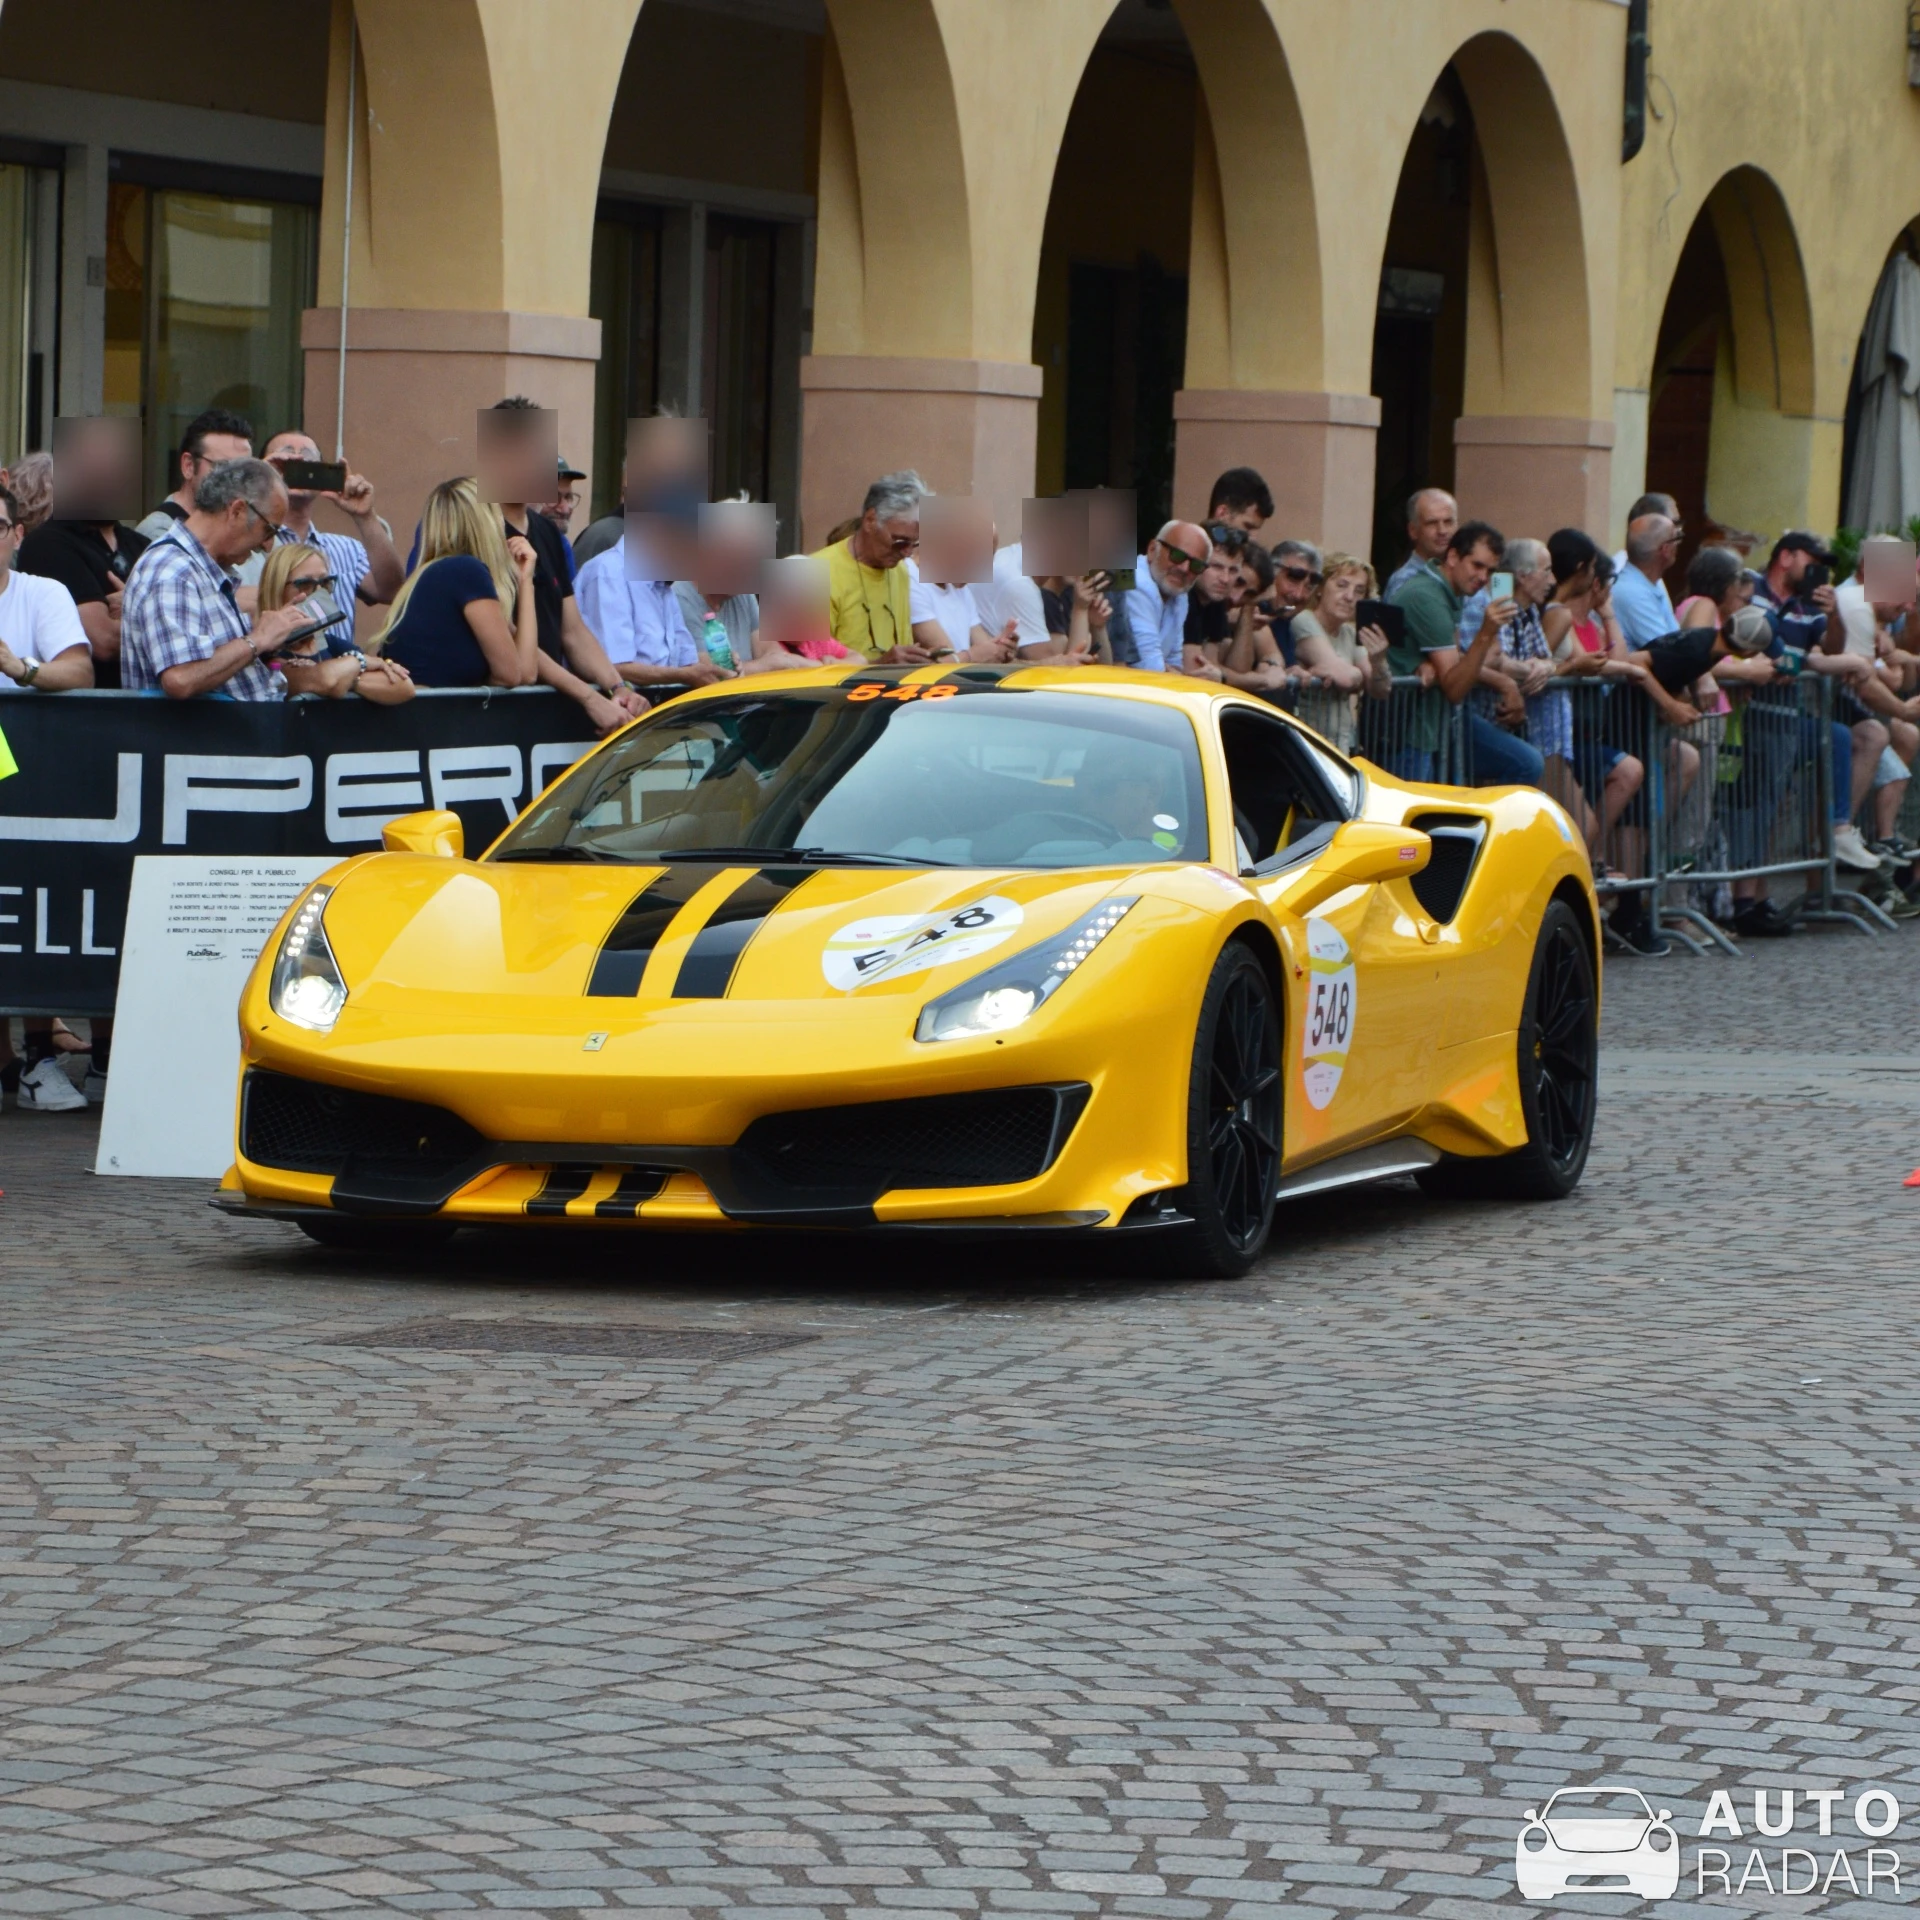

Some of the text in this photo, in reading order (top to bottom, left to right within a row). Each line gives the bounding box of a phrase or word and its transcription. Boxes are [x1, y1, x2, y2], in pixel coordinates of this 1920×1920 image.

[846, 684, 960, 701] 548
[853, 906, 996, 976] 548
[1311, 981, 1350, 1047] 548
